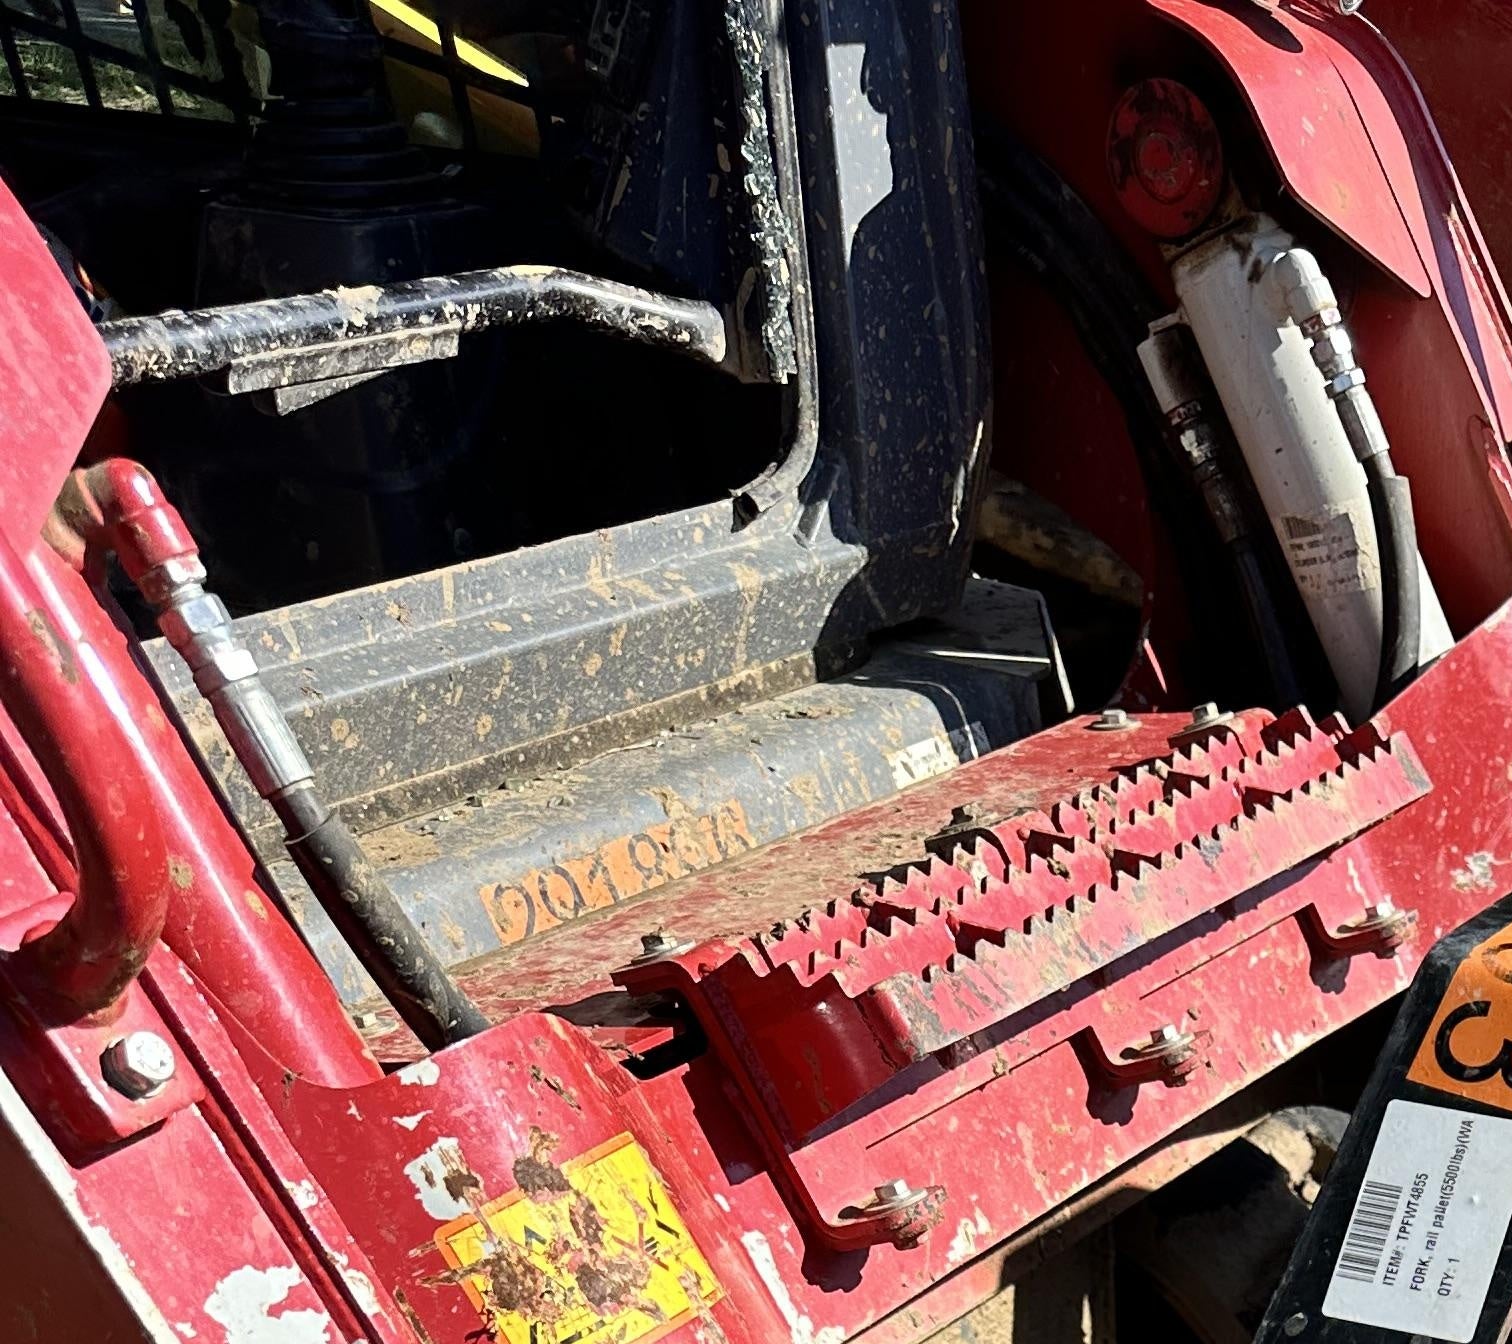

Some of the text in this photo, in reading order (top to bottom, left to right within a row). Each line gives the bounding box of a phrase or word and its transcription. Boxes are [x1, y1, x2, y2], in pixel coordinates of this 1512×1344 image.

[1396, 1172, 1429, 1241] TPFWT4855
[1425, 1231, 1440, 1253] rail
[1437, 1267, 1457, 1296] QTY:
